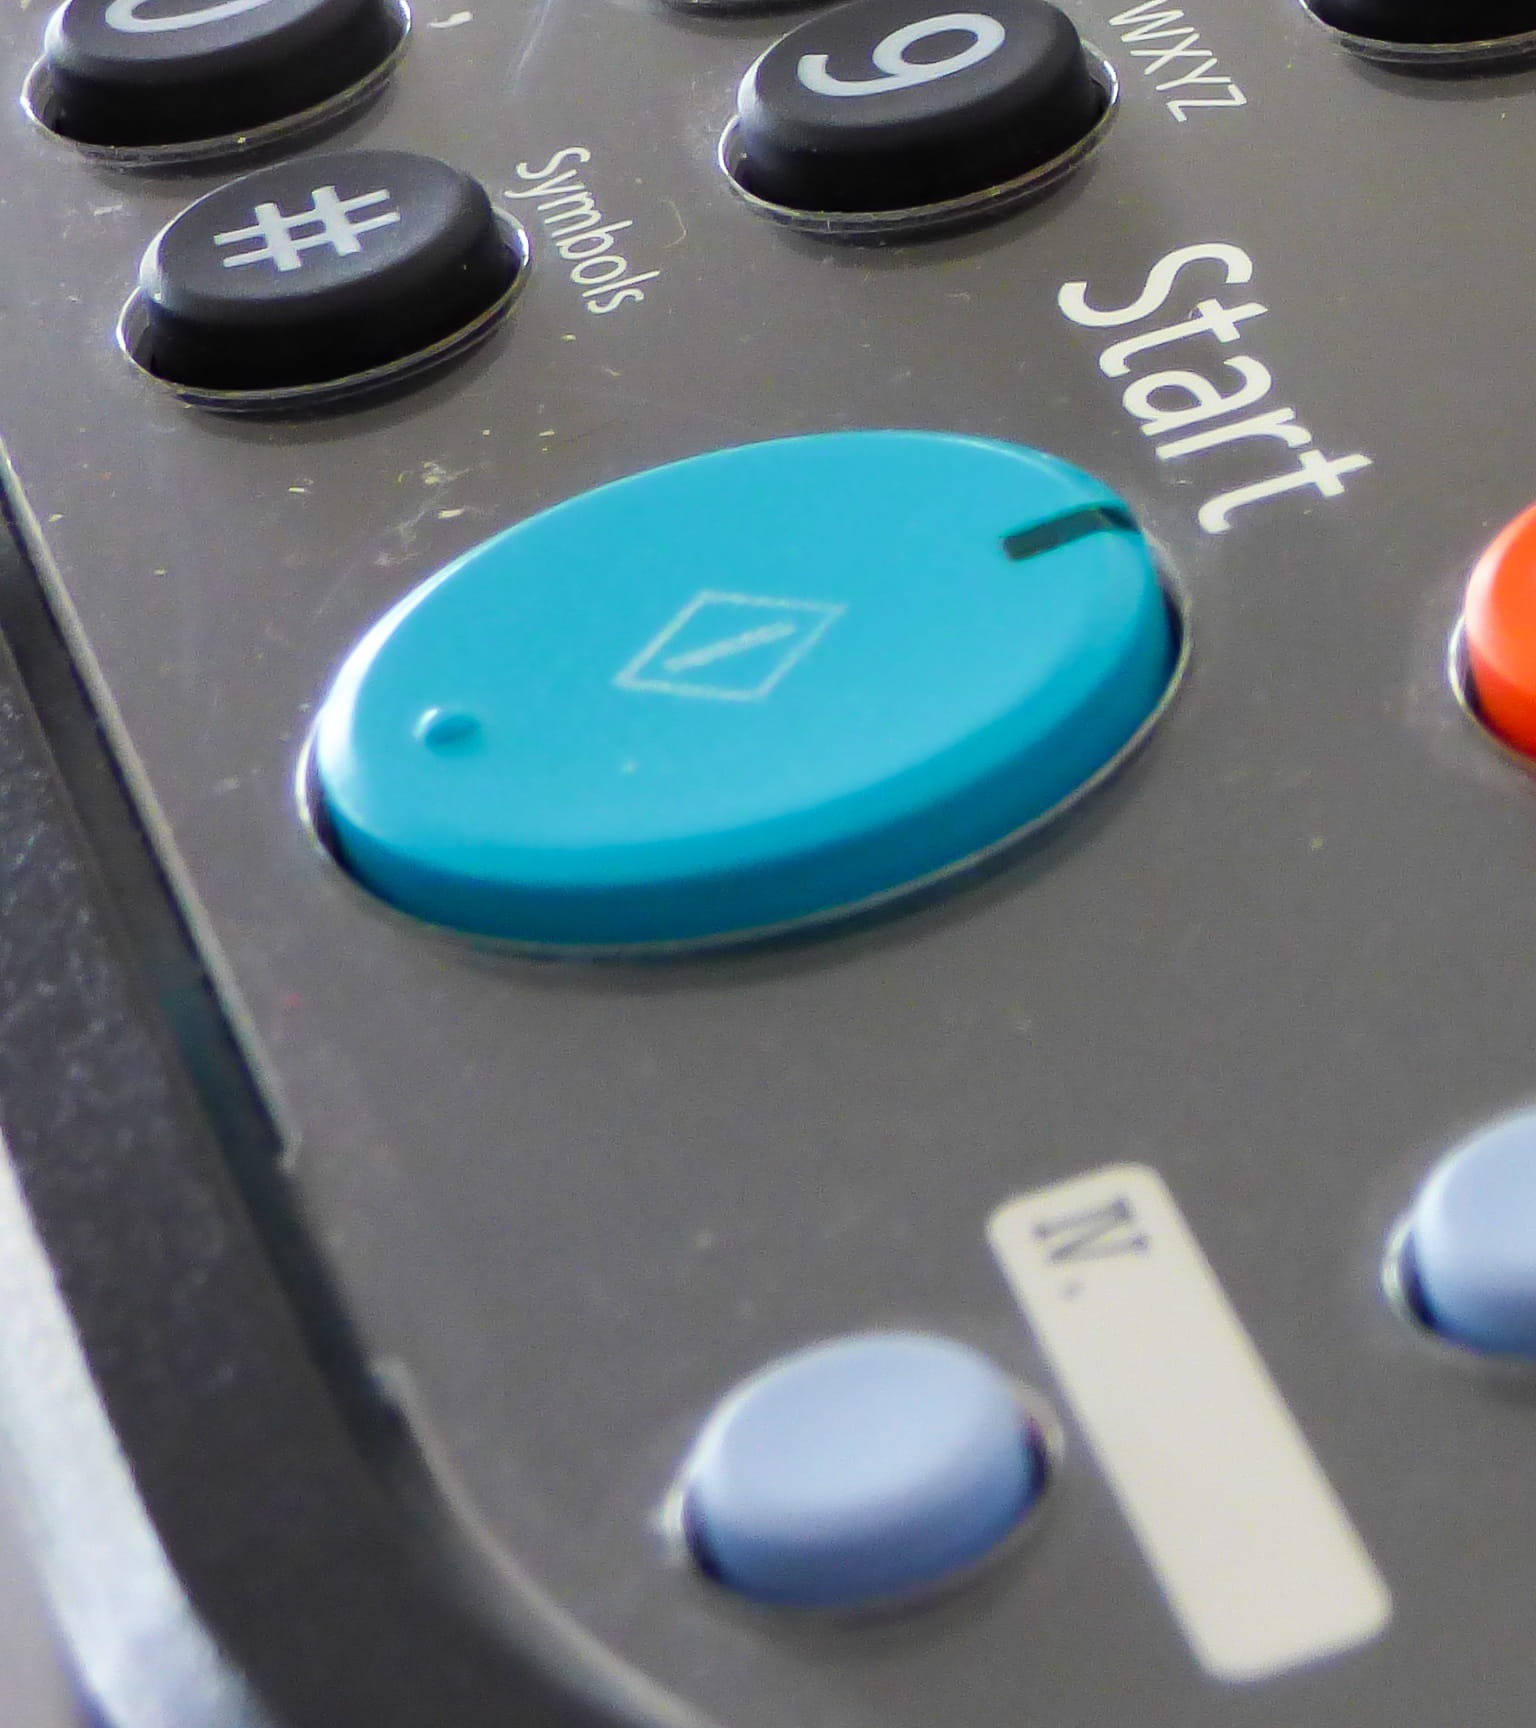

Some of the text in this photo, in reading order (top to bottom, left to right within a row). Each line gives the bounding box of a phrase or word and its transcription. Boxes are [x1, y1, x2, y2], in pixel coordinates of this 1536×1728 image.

[798, 13, 1006, 97] 9
[212, 186, 400, 271] #
[515, 146, 661, 315] Symbols
[1057, 242, 1374, 534] Start
